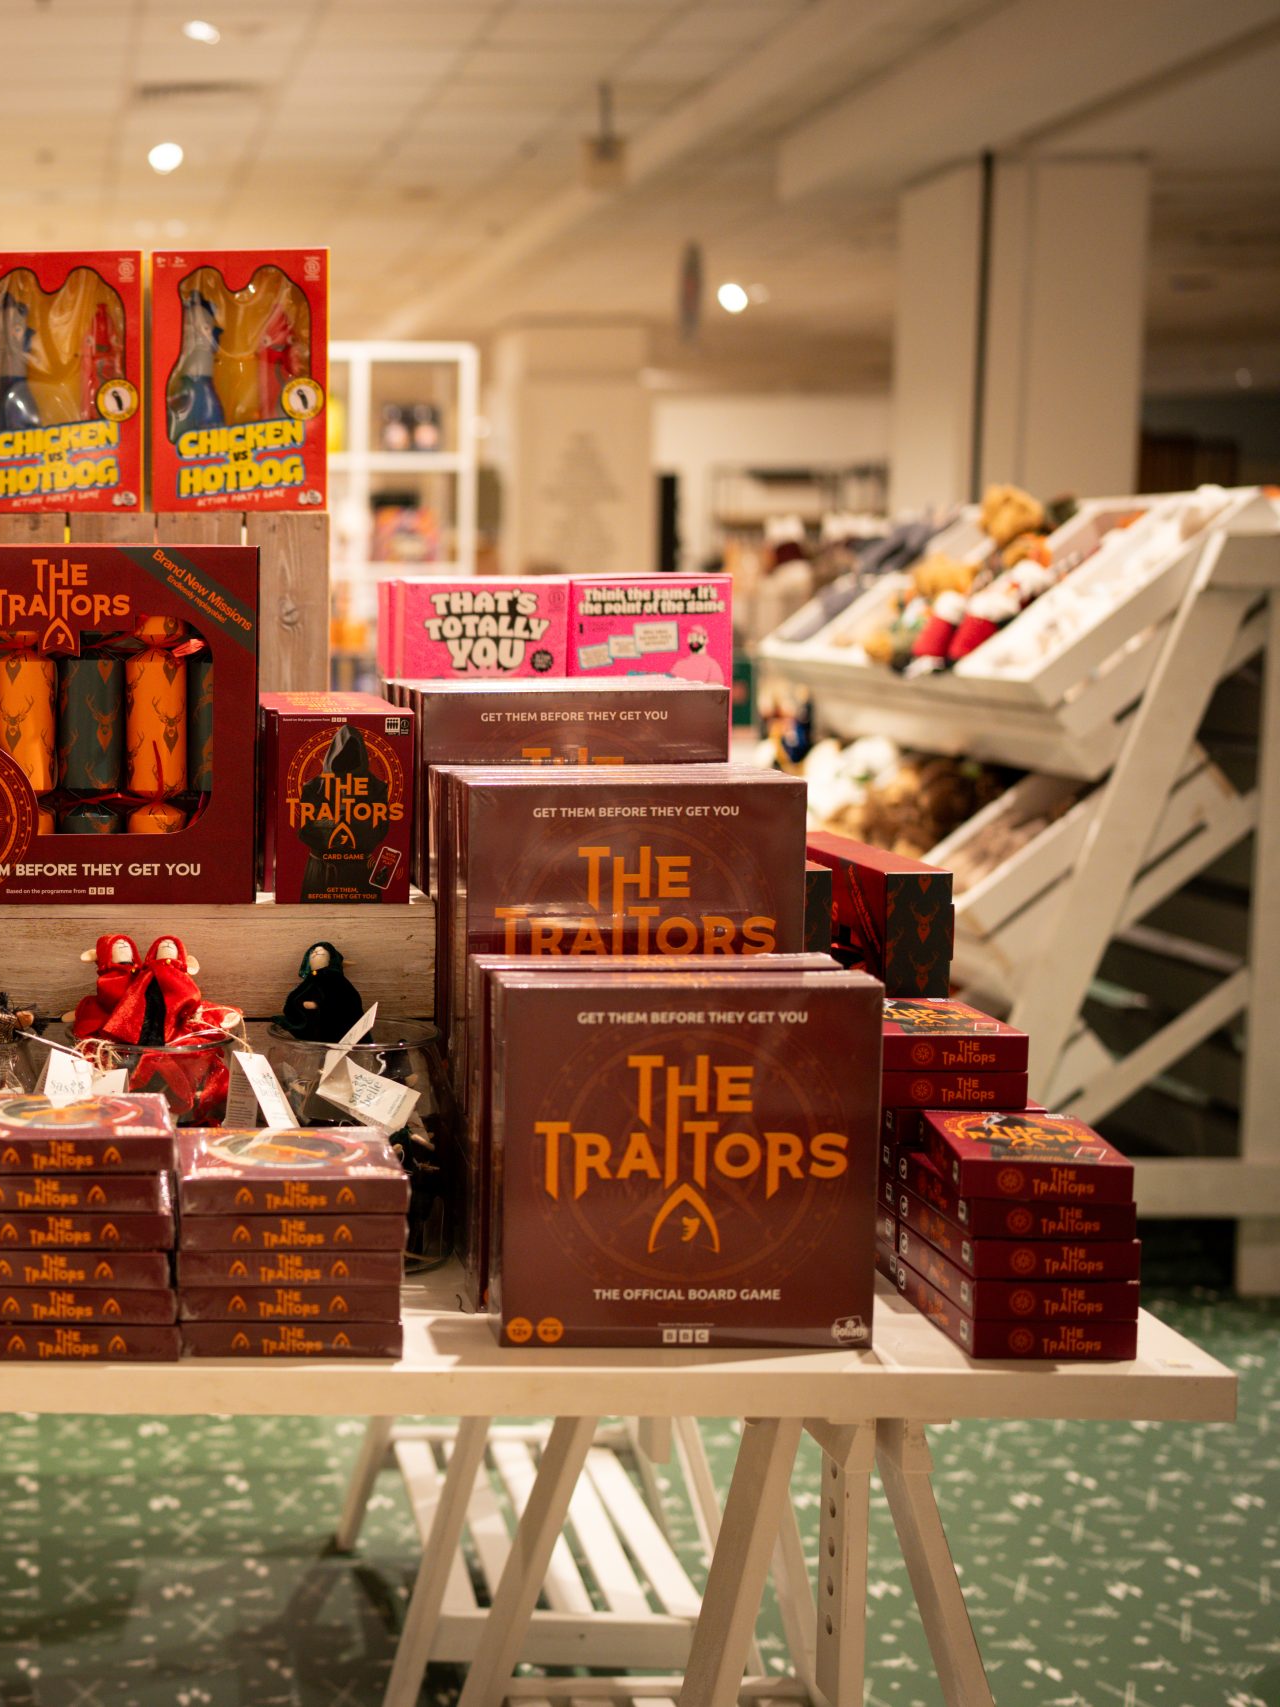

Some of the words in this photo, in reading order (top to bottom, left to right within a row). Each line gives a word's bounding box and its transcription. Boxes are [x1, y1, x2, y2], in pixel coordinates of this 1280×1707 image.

[178, 419, 305, 459] CHICKEN
[233, 450, 248, 461] VS
[179, 455, 304, 498] HOTDOG
[32, 558, 88, 593] THE
[152, 549, 187, 578] Brand
[184, 573, 209, 597] New
[207, 592, 253, 631] Missions
[584, 587, 627, 602] Think
[626, 587, 653, 601] the
[430, 588, 539, 616] THAT'S
[578, 601, 603, 616] the
[604, 601, 643, 616] point
[643, 600, 659, 614] of
[660, 600, 685, 614] the
[424, 614, 551, 641] TOTALLY
[446, 637, 526, 669] YOU
[481, 712, 504, 723] GET
[505, 712, 537, 723] THEM
[540, 711, 584, 722] BEFORE
[587, 711, 617, 722] THEY
[619, 711, 642, 722] GET
[644, 710, 668, 722] YOU
[320, 772, 369, 801] THE
[285, 798, 405, 829] TRAITORS
[533, 808, 558, 819] GET
[560, 808, 596, 819] THEM
[598, 807, 647, 818] BEFORE
[650, 807, 683, 818] THEY
[685, 807, 710, 818] GET
[712, 806, 740, 818] YOU
[15, 863, 78, 877] BEFORE
[81, 863, 124, 877] THEY
[127, 863, 161, 877] GET
[166, 863, 202, 877] YOU
[578, 846, 692, 911] THE
[88, 886, 115, 896] BBC
[577, 1012, 605, 1024] GET
[608, 1012, 648, 1024] THEM
[650, 1012, 705, 1024] BEFORE
[708, 1011, 745, 1023] THEY
[748, 1011, 775, 1023] GET
[778, 1011, 809, 1023] YOU
[958, 1040, 980, 1053] THE
[942, 1051, 996, 1066] TRAITORS
[956, 1077, 979, 1089] THE
[626, 1055, 755, 1129] THE
[941, 1088, 996, 1103] TRAITORS
[49, 1141, 75, 1154] THE
[32, 1153, 94, 1170] TRAITORS
[533, 1120, 850, 1201] TRAITORS
[1050, 1167, 1076, 1181] THE
[34, 1178, 60, 1191] THE
[283, 1181, 310, 1194] THE
[1032, 1179, 1095, 1196] TRAITORS
[16, 1190, 78, 1208] TRAITORS
[265, 1194, 328, 1210] TRAITORS
[593, 1288, 620, 1300] THE
[622, 1288, 685, 1300] OFFICIAL
[687, 1289, 737, 1300] BOARD
[739, 1289, 781, 1300] GAME
[55, 1328, 81, 1342] THE
[280, 1326, 305, 1340] THE
[662, 1329, 709, 1343] BBC
[1059, 1326, 1084, 1339] THE
[37, 1341, 99, 1357] TRAITORS
[261, 1339, 323, 1355] TRAITORS
[1041, 1338, 1102, 1355] TRAITORS
